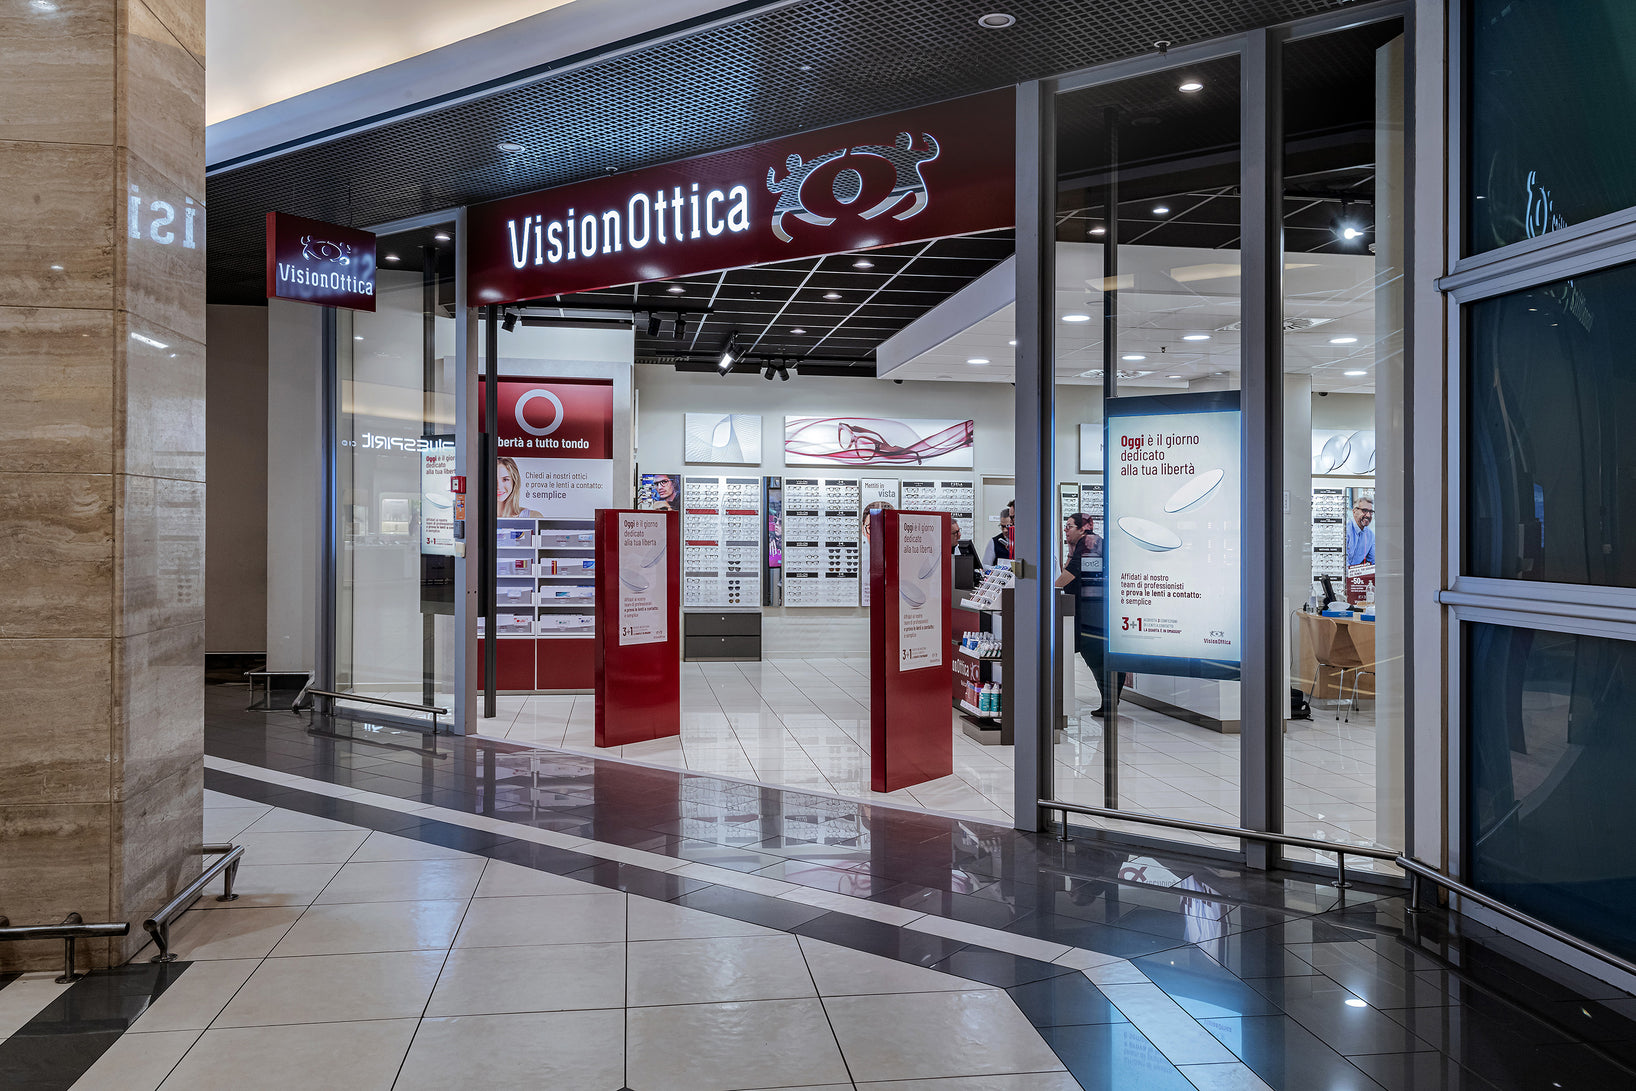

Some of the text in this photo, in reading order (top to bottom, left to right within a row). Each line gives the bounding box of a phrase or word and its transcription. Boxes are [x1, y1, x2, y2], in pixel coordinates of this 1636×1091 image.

[508, 182, 750, 269] VisionOttica
[278, 262, 373, 295] VisionOttica
[526, 440, 533, 448] a
[535, 438, 559, 449] tutto
[561, 438, 590, 449] tondo
[1121, 433, 1200, 450] Oggi è il giorno
[1120, 450, 1165, 461] dedicato
[1120, 463, 1195, 476] alla tua libertà
[525, 471, 544, 480] Chiedi
[546, 472, 552, 480] ai
[553, 472, 571, 480] nostri
[530, 482, 548, 490] prova
[549, 481, 555, 489] le
[556, 481, 570, 489] lenti
[532, 490, 567, 500] semplice
[878, 489, 896, 498] vista
[1121, 573, 1142, 581] Affidati
[1150, 574, 1169, 582] nostro
[1137, 581, 1142, 589] di
[1144, 582, 1185, 591] professionisti
[1126, 590, 1143, 598] prova
[1151, 590, 1166, 598] lenti
[1172, 591, 1202, 599] contatto:
[1125, 598, 1152, 606] semplice
